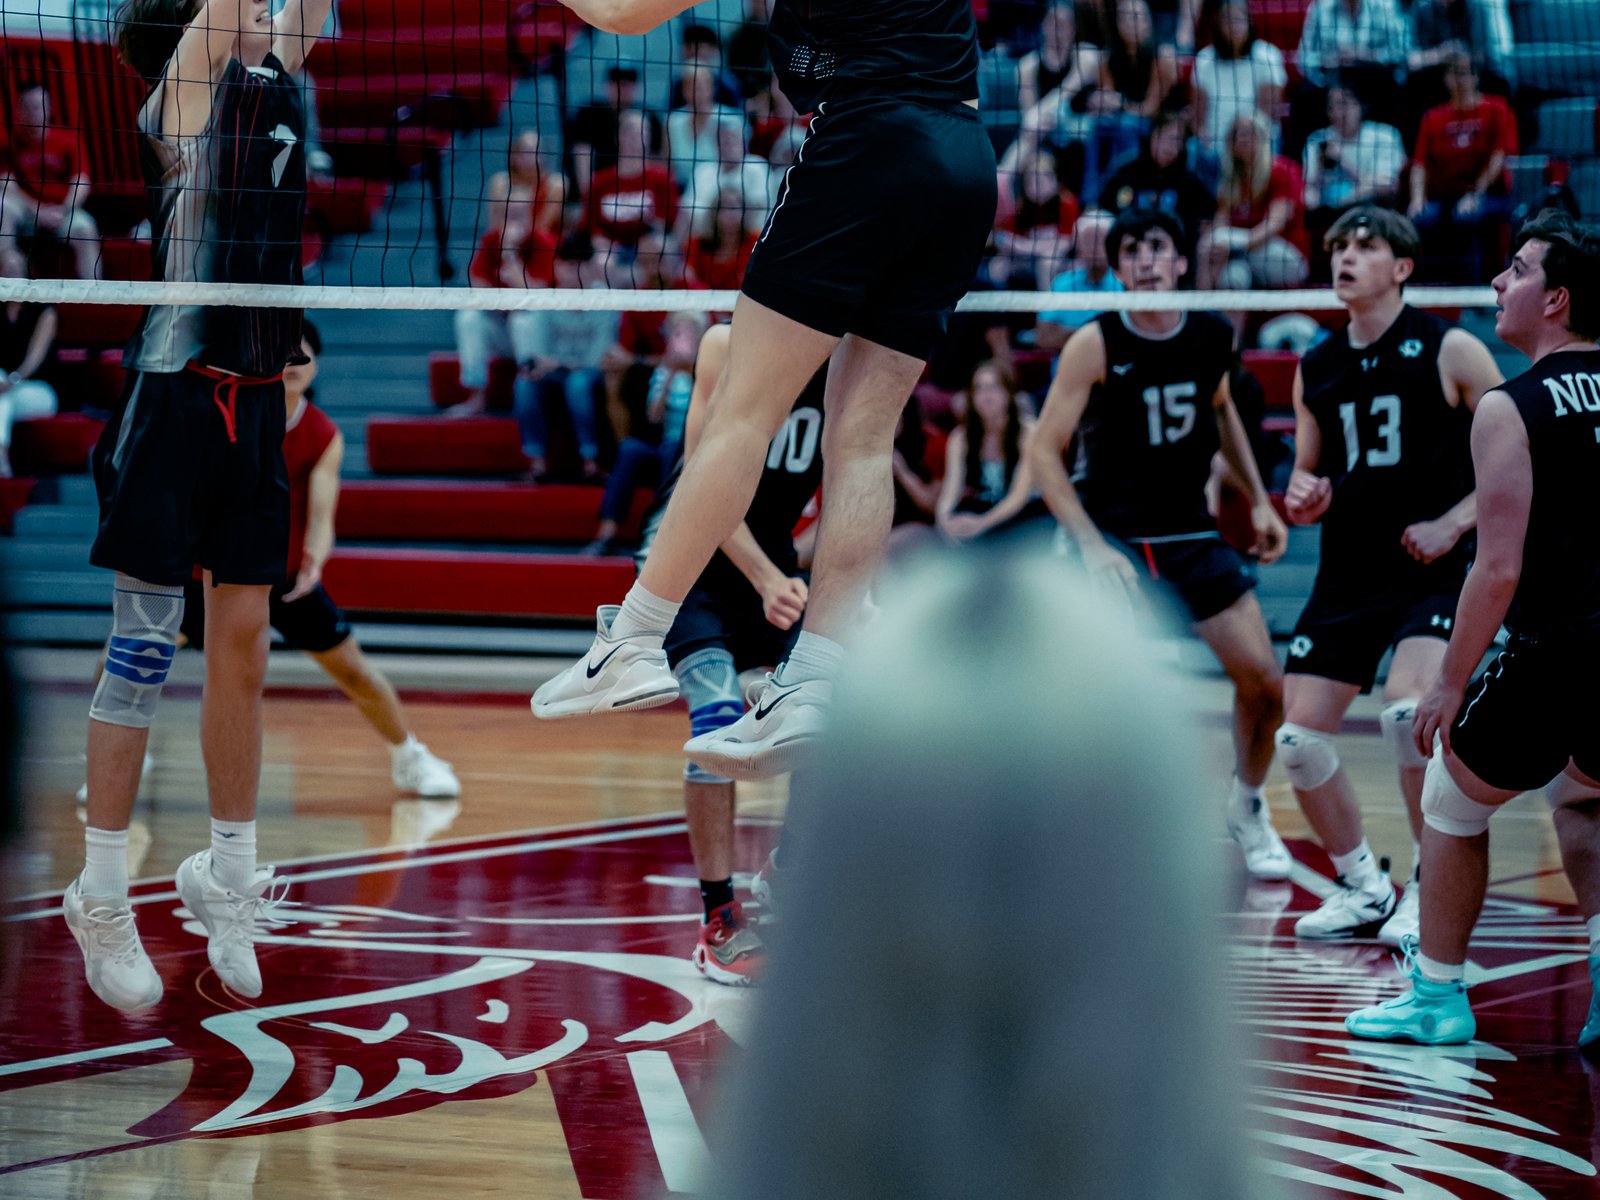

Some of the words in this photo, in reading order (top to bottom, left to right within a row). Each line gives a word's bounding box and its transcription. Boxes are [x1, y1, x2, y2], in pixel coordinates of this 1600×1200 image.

[268, 123, 299, 189] 7
[1142, 381, 1197, 446] 15
[1339, 394, 1401, 473] 13
